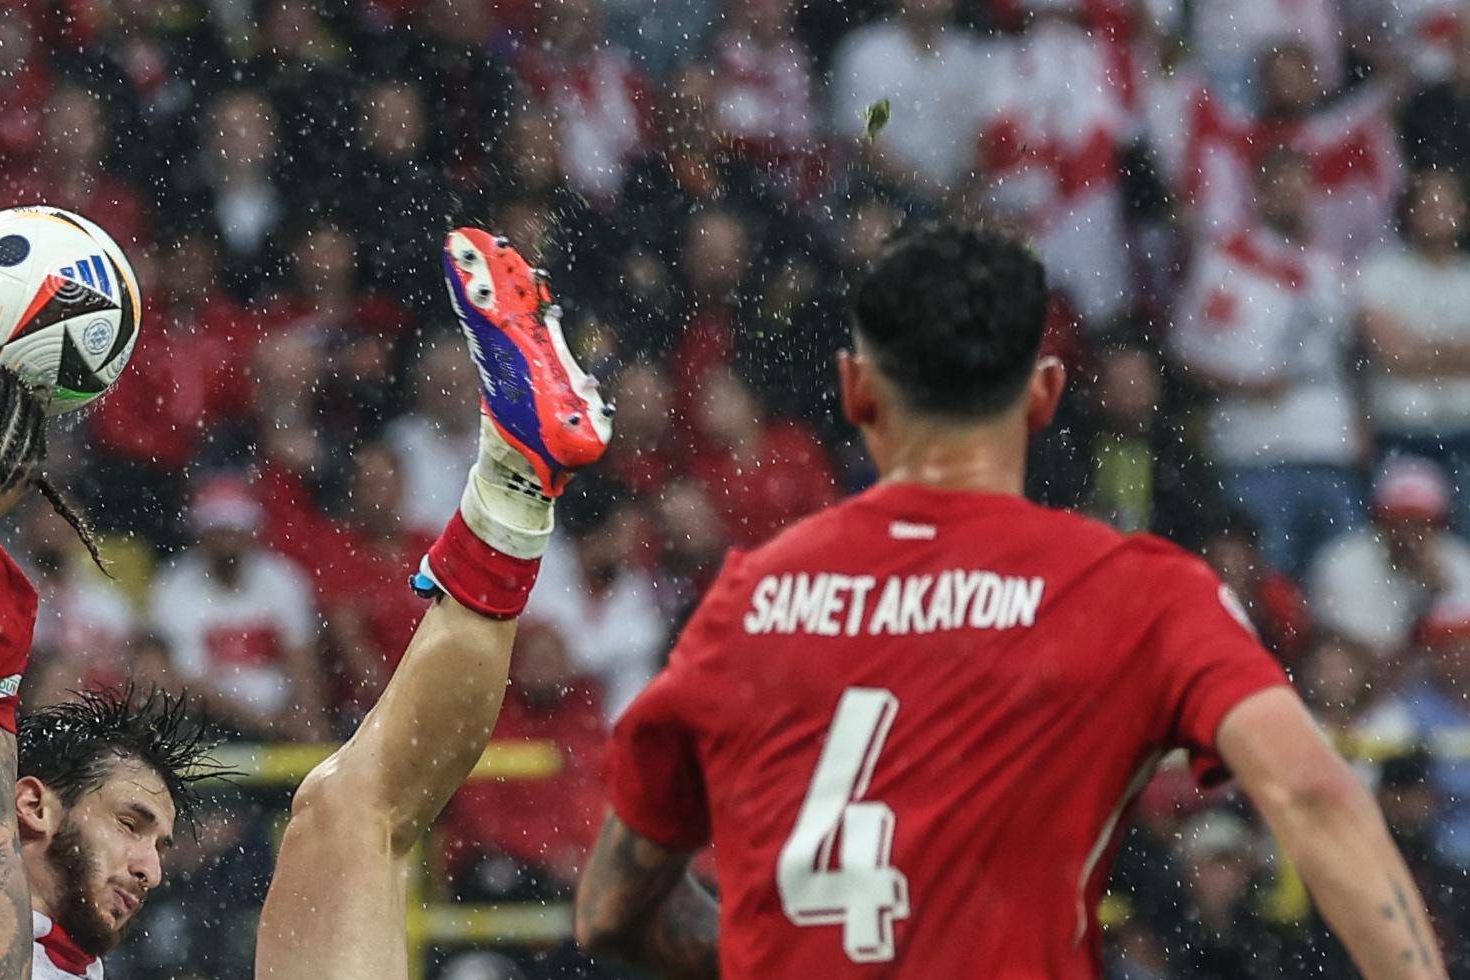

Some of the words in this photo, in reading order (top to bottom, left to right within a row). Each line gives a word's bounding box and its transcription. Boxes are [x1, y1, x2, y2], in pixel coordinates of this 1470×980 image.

[743, 571, 876, 637] SAMET
[868, 568, 1045, 636] AKAYDIN
[776, 686, 910, 963] 4
